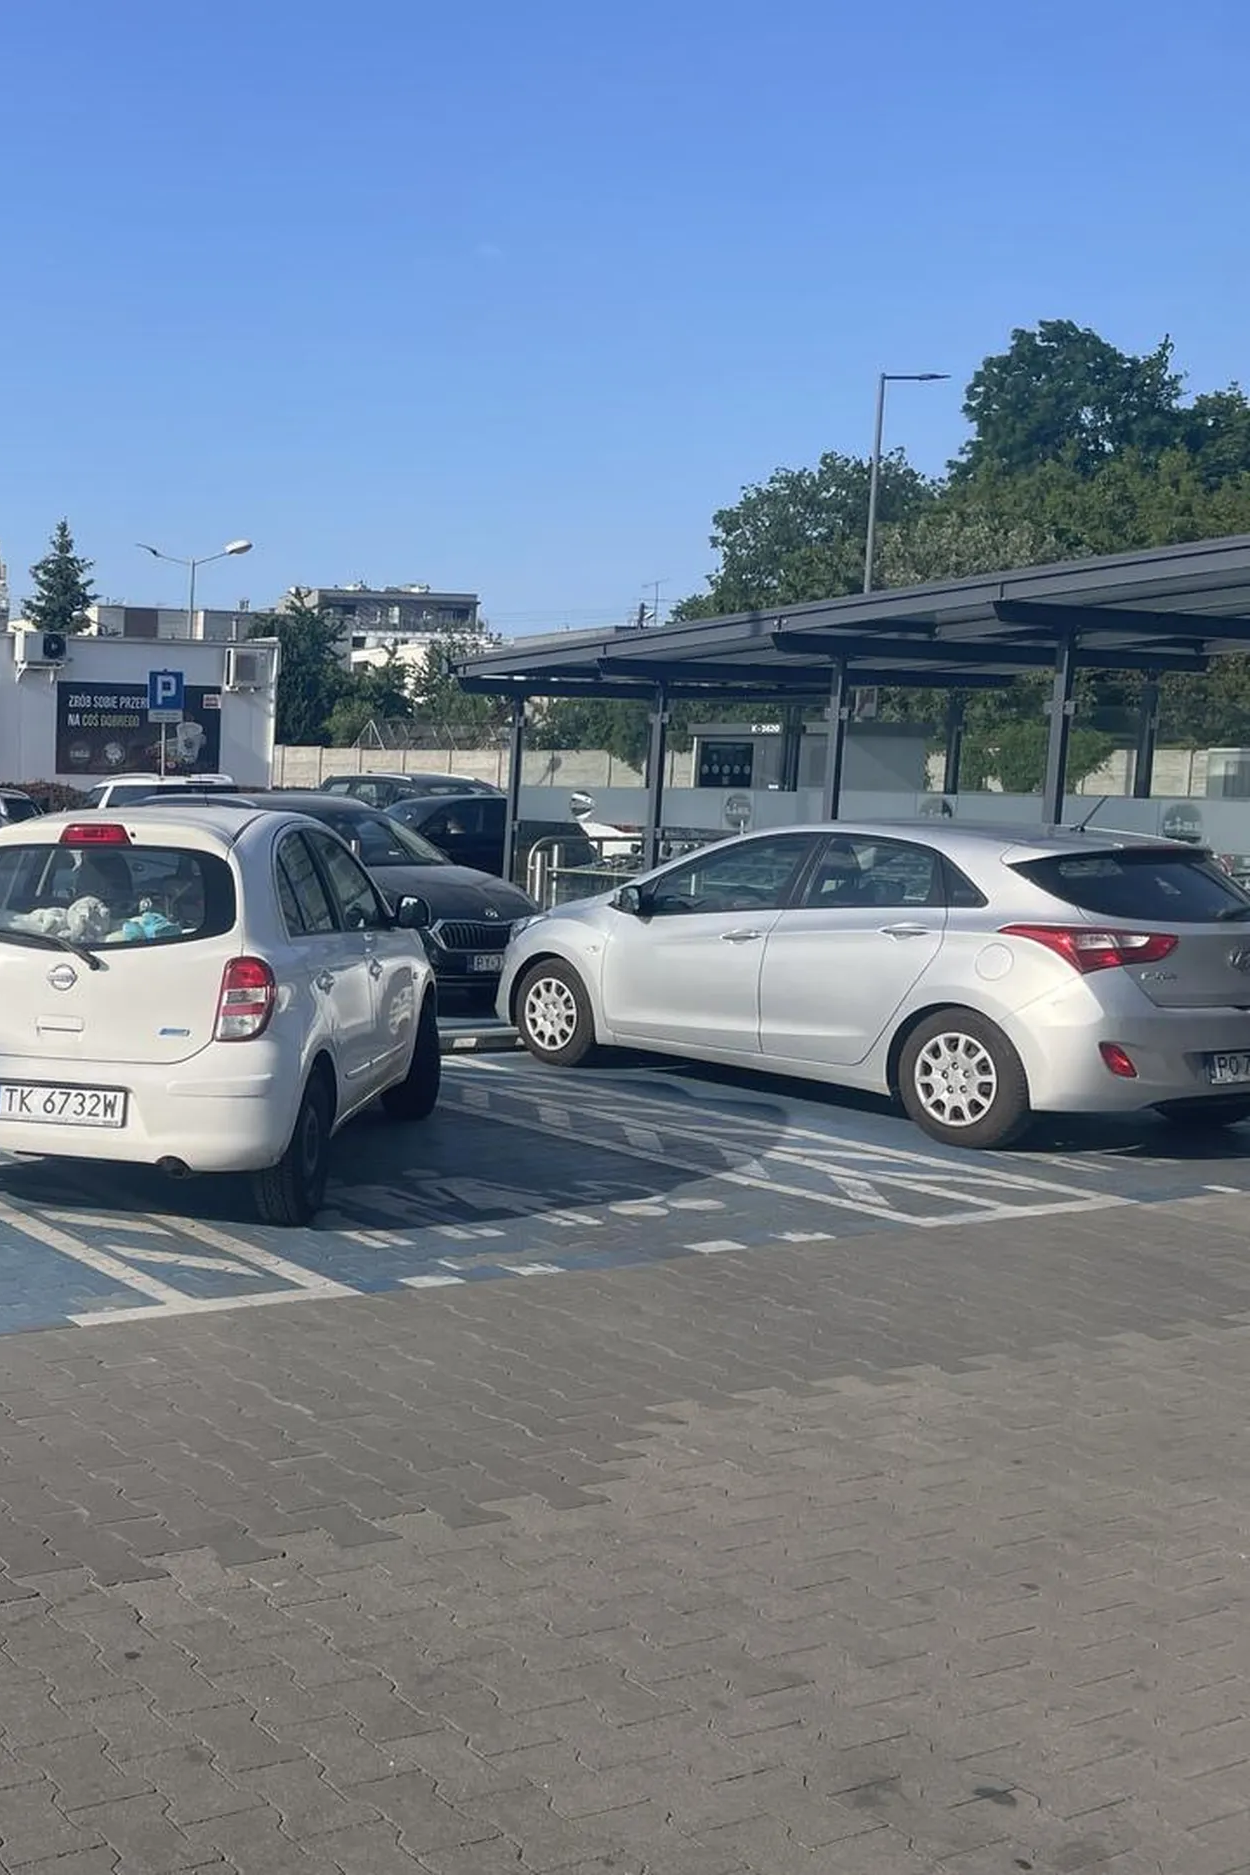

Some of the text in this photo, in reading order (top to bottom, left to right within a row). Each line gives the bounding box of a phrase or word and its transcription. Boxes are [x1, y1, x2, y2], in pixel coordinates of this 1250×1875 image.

[157, 675, 176, 705] P
[119, 697, 149, 709] PRZER
[68, 714, 80, 726] NA
[4, 1088, 118, 1119] TK 6732W
